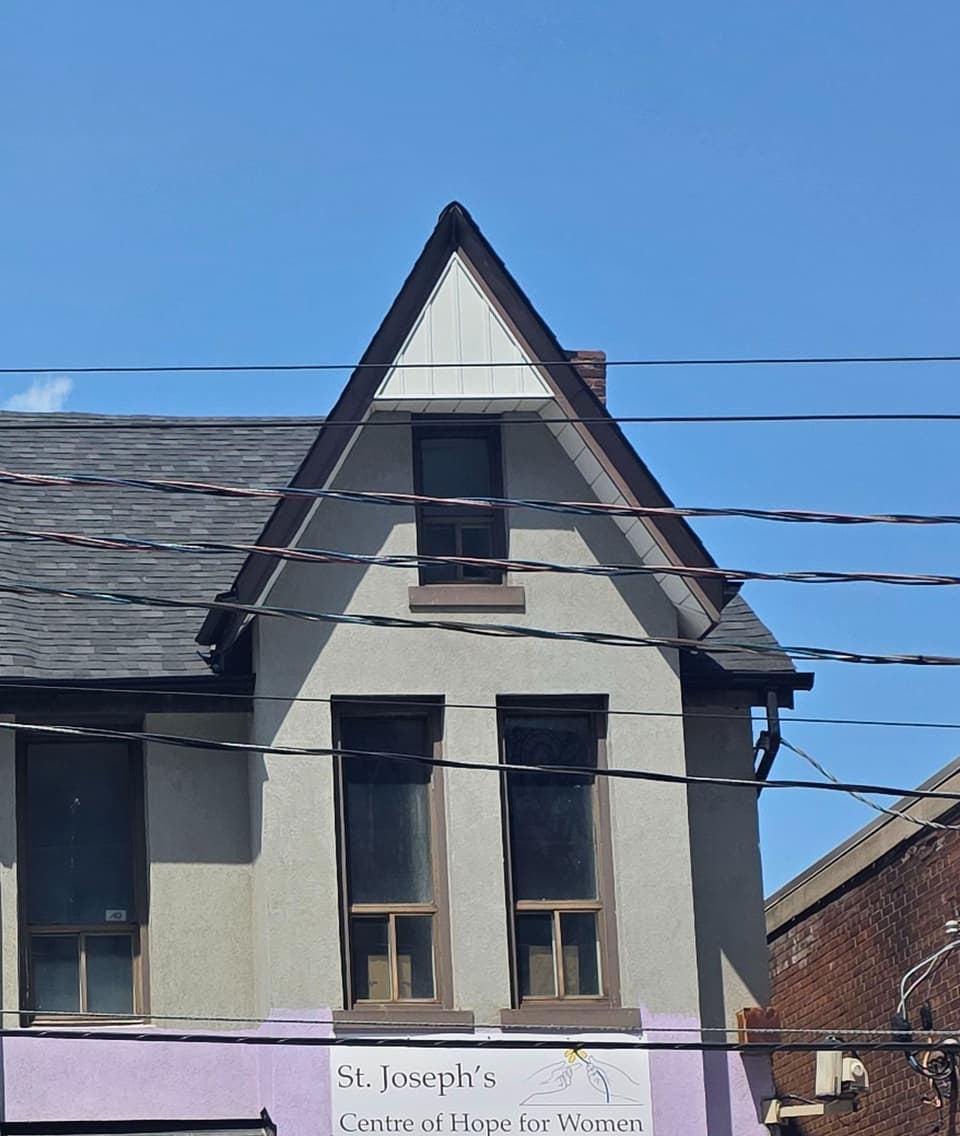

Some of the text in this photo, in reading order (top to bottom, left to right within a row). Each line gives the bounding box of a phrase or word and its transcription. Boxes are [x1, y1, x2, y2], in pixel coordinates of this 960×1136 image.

[337, 1063, 497, 1096] St. Joseph's
[339, 1113, 414, 1133] Centre
[421, 1112, 444, 1133] of
[519, 1112, 551, 1133] for
[557, 1113, 644, 1133] Women
